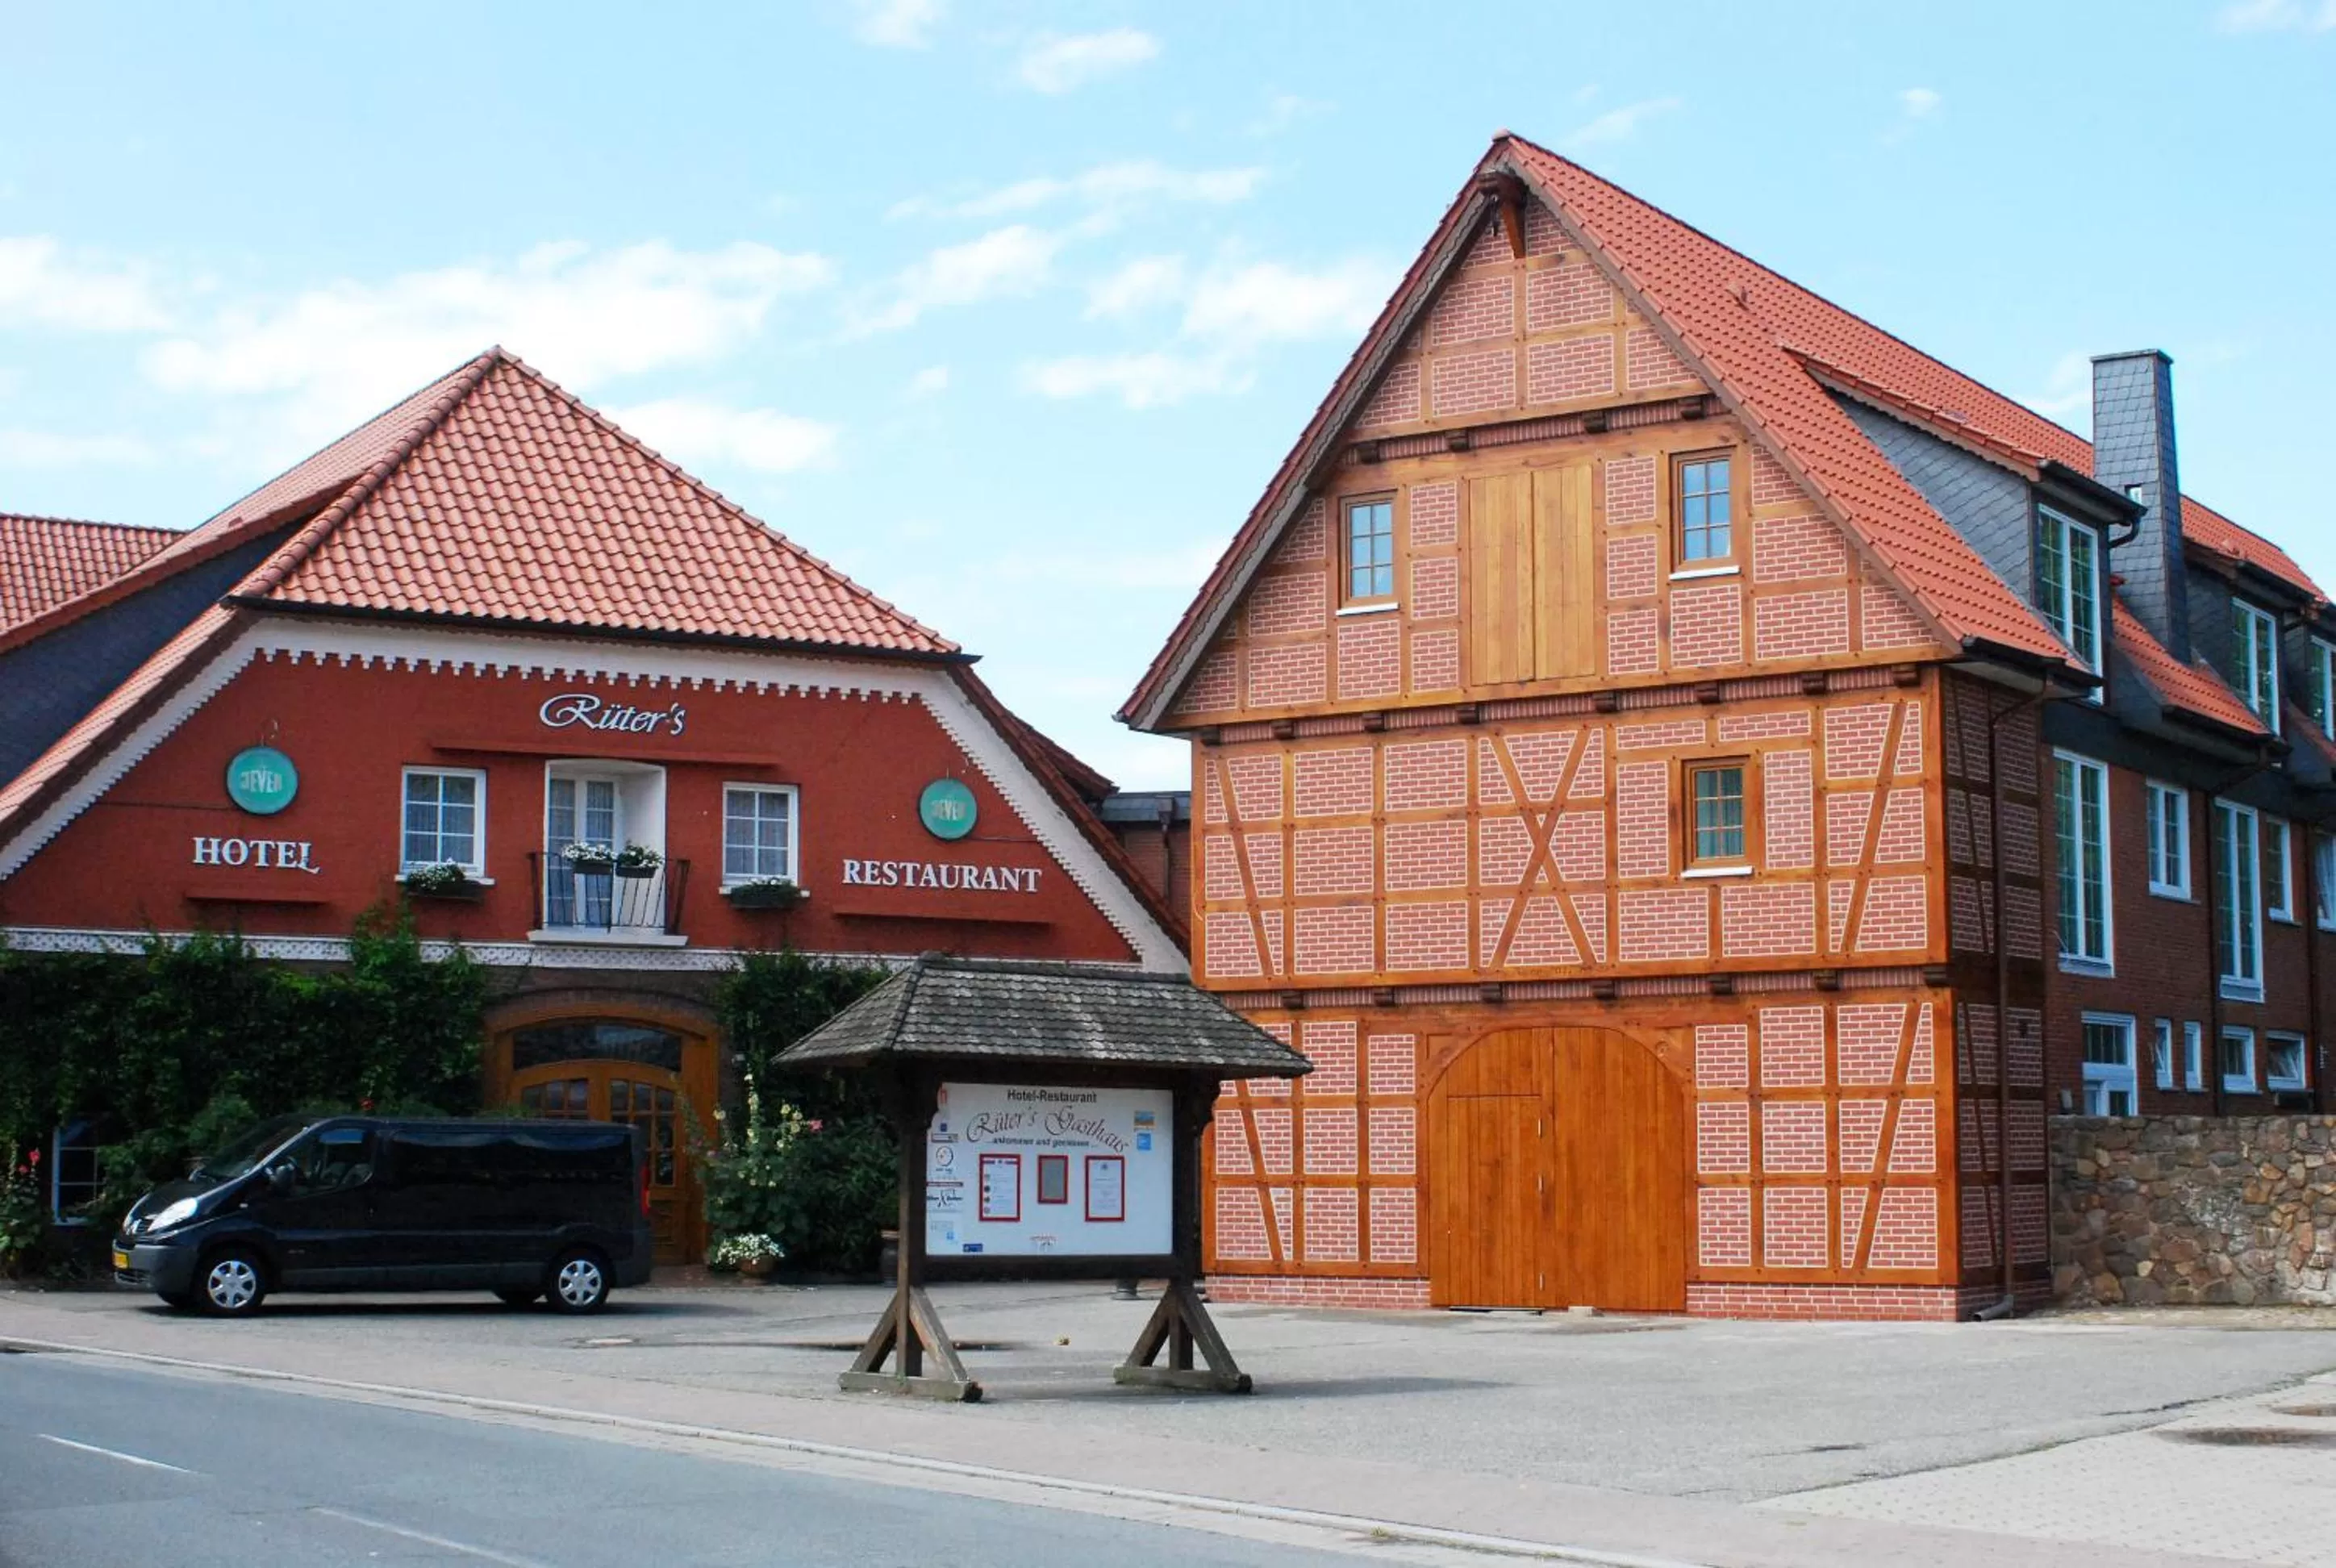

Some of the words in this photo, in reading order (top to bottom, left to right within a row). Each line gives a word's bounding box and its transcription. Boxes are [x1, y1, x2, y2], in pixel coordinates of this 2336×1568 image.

[539, 694, 686, 736] Rüter's
[192, 836, 321, 874] HOTEL
[841, 859, 1043, 893] RESTAURANT
[1007, 1090, 1098, 1103] Hotel-Restaurant
[1045, 1105, 1130, 1153] Gasthaus
